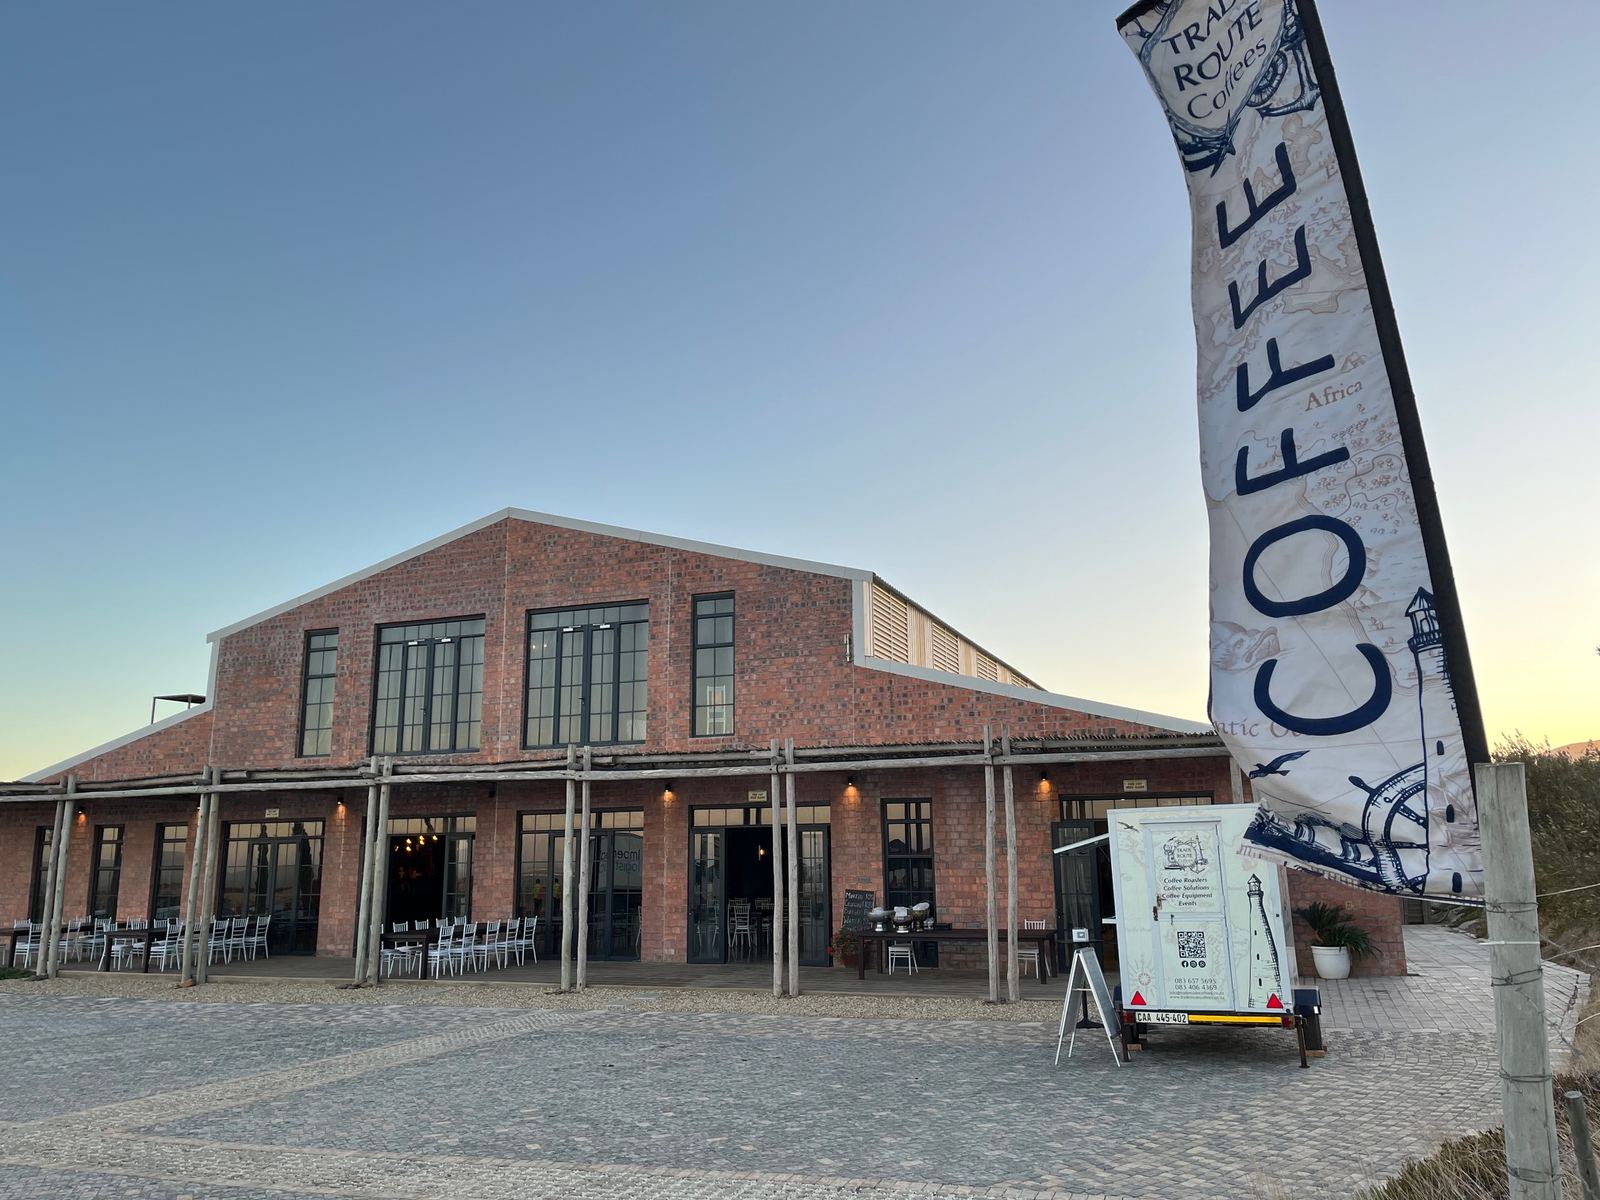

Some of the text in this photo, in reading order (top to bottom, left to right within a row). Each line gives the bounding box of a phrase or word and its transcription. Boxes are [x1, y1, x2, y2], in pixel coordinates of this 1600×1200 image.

[1174, 1, 1262, 91] ROUTE
[1187, 38, 1267, 119] Coffees
[1305, 381, 1363, 412] Africa
[1216, 141, 1392, 736] COFFEE
[1137, 1012, 1187, 1024] CAA 445-402
